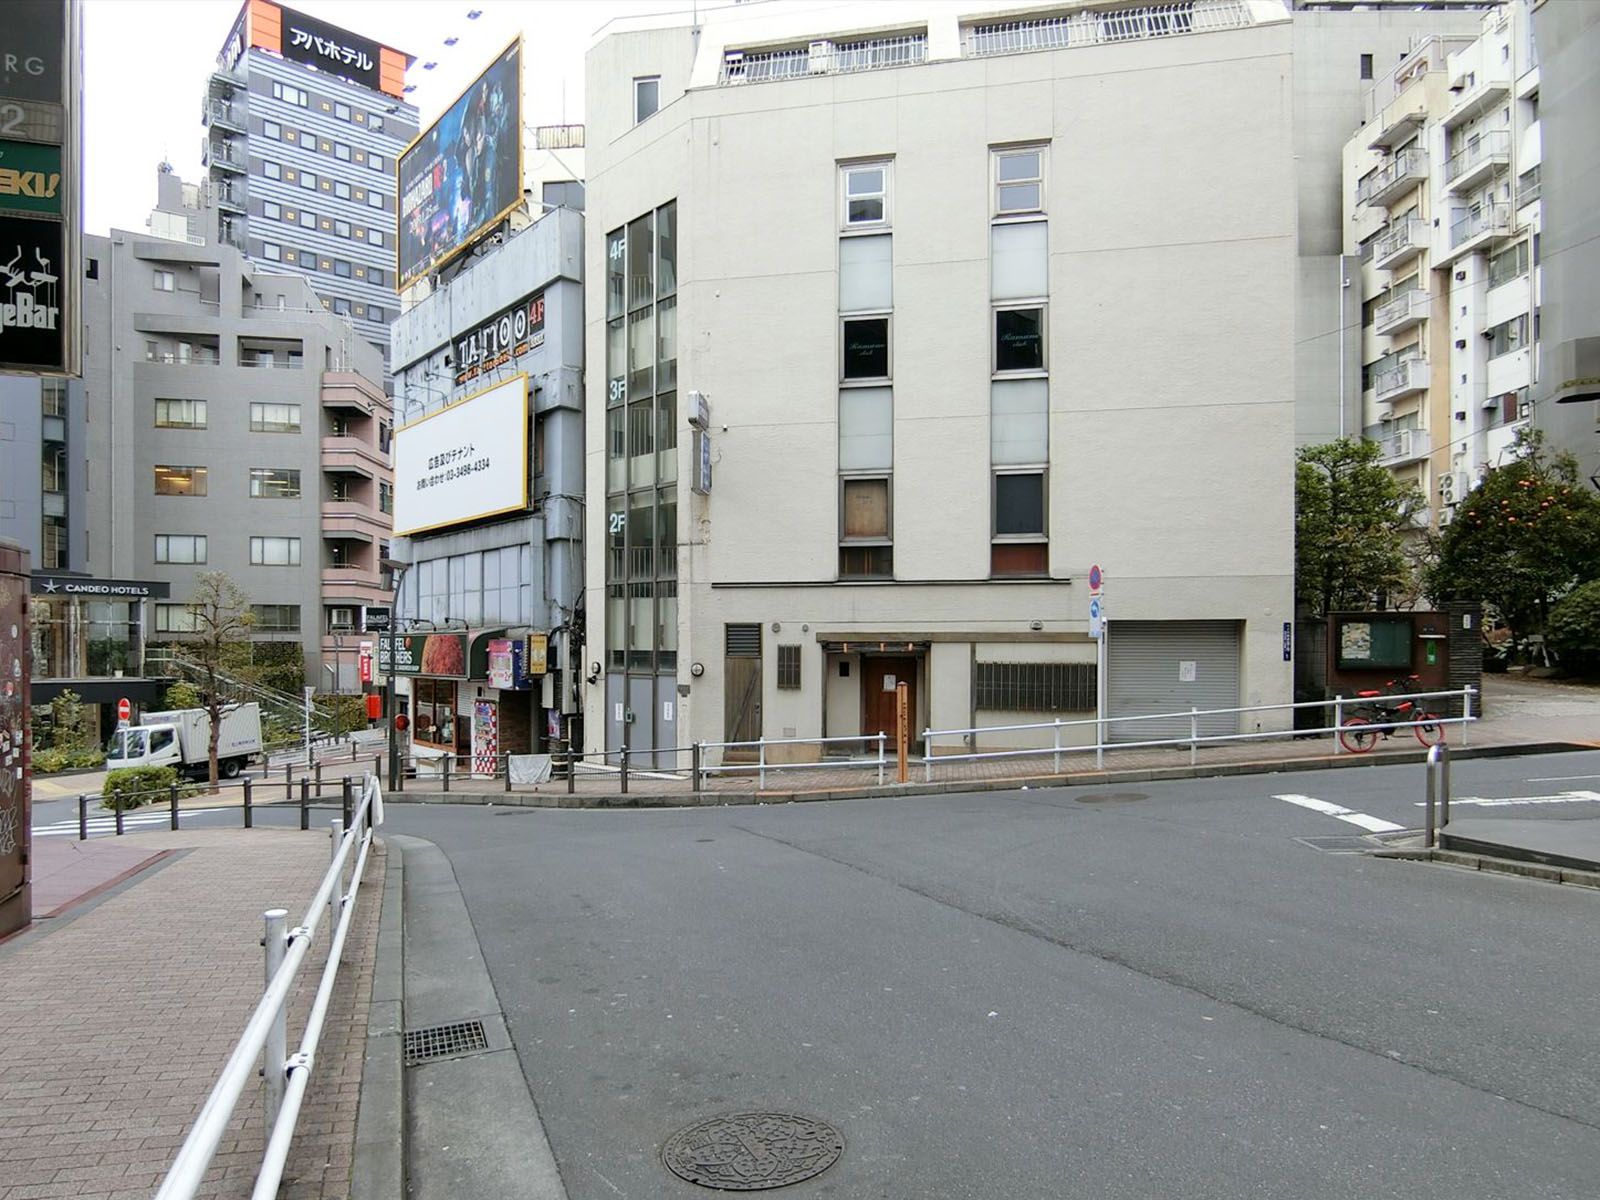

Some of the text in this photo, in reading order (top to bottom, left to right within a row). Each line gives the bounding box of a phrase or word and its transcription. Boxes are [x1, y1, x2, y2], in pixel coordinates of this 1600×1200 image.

[290, 27, 374, 71] アパホテル
[610, 238, 625, 260] 4F
[0, 292, 59, 334] eBar
[610, 380, 625, 401] 3F
[609, 513, 625, 533] 2F
[65, 583, 149, 596] CANDEO HOTELS
[379, 637, 406, 650] FALFEL
[379, 650, 413, 665] BRHERS
